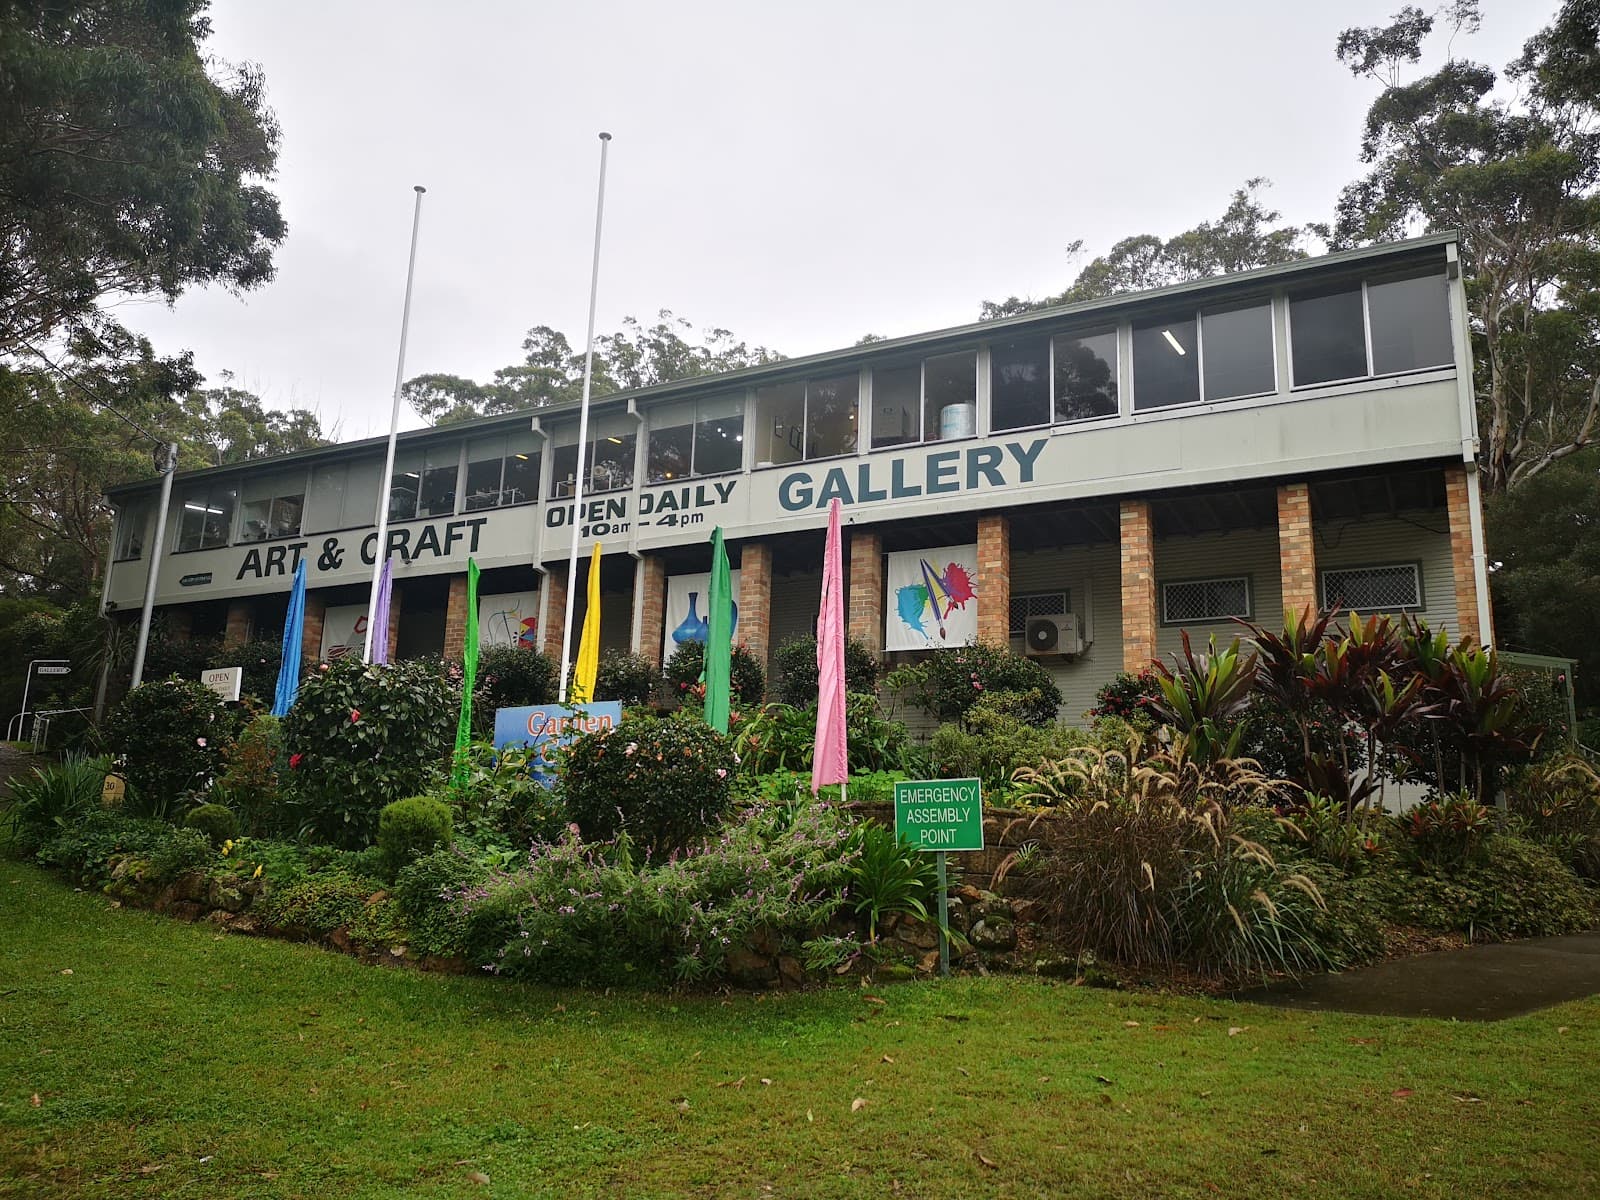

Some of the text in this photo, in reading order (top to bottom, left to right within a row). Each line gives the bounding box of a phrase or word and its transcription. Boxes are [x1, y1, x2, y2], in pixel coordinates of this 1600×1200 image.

[778, 438, 1048, 511] GALLERY
[546, 480, 737, 527] OPEN DAILY
[656, 512, 704, 527] 4pm
[236, 518, 488, 580] ART & CRAFT
[208, 672, 230, 683] OPEN
[900, 786, 976, 804] EMERGENCY
[906, 807, 971, 824] ASSEMBLY
[920, 828, 957, 844] POINT
